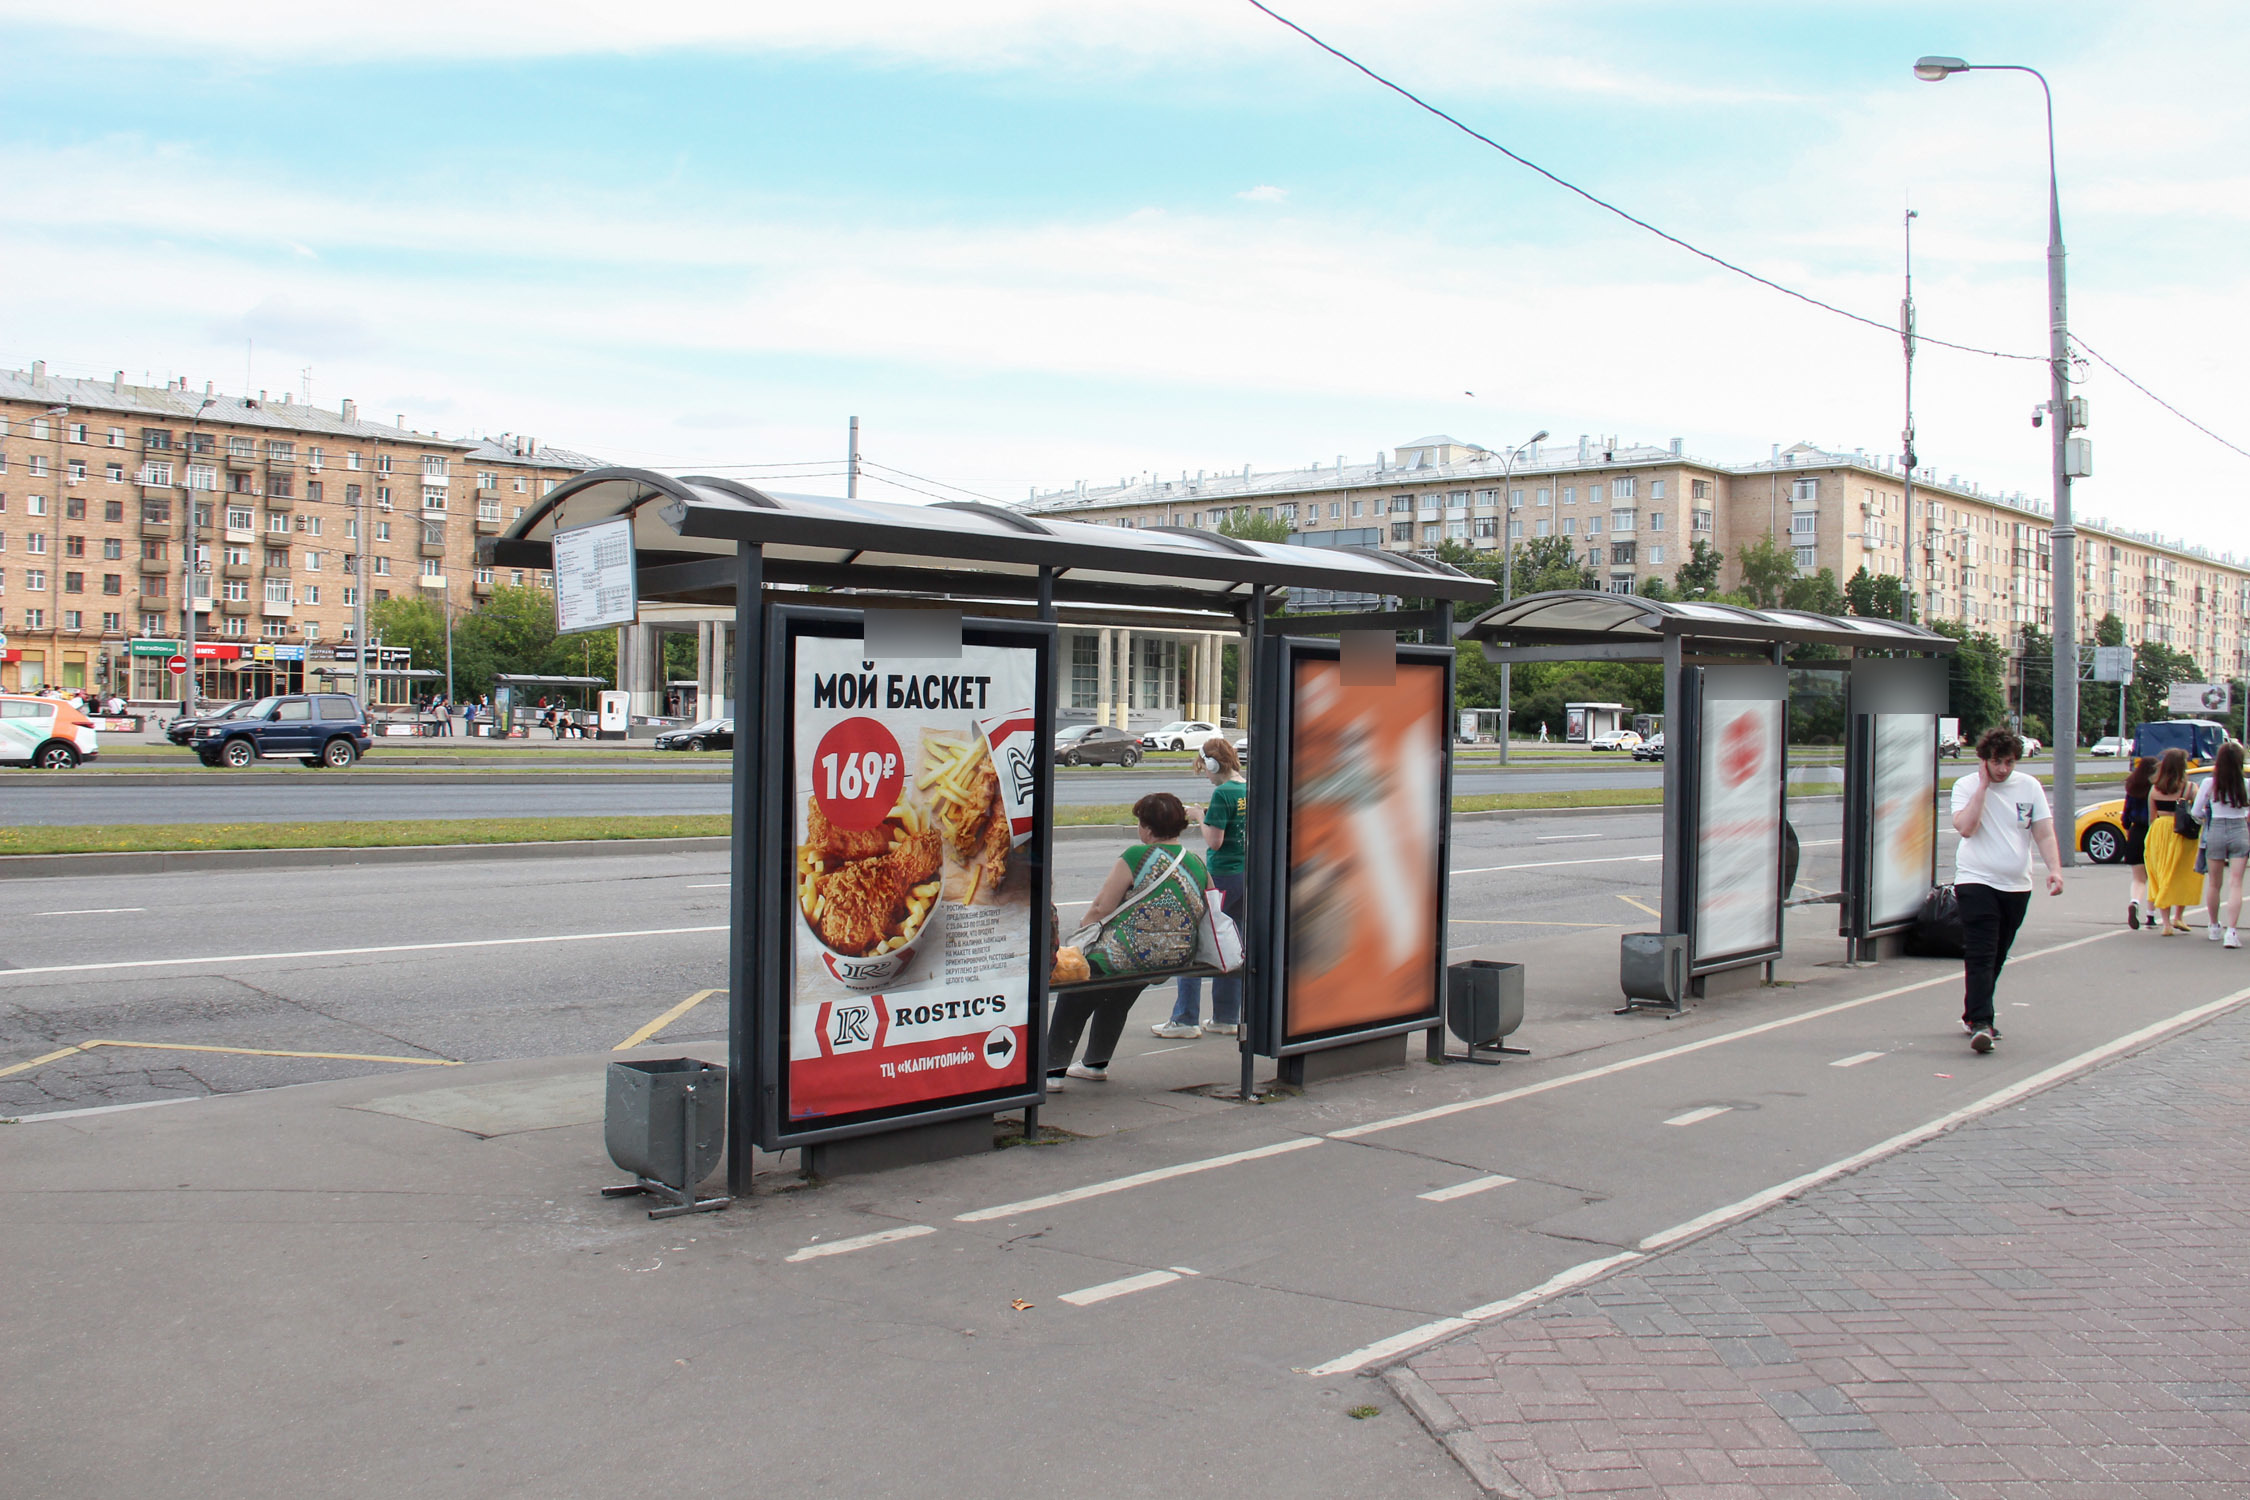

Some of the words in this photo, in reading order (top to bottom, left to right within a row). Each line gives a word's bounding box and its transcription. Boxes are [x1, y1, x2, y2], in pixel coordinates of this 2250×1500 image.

[814, 661, 877, 708] МОЙ
[887, 674, 991, 709] БАСКЕТ
[895, 994, 1006, 1027] ROSTIC'S
[880, 1062, 896, 1078] ТЦ
[898, 1046, 976, 1074] «КАПИТОЛИЙ»
